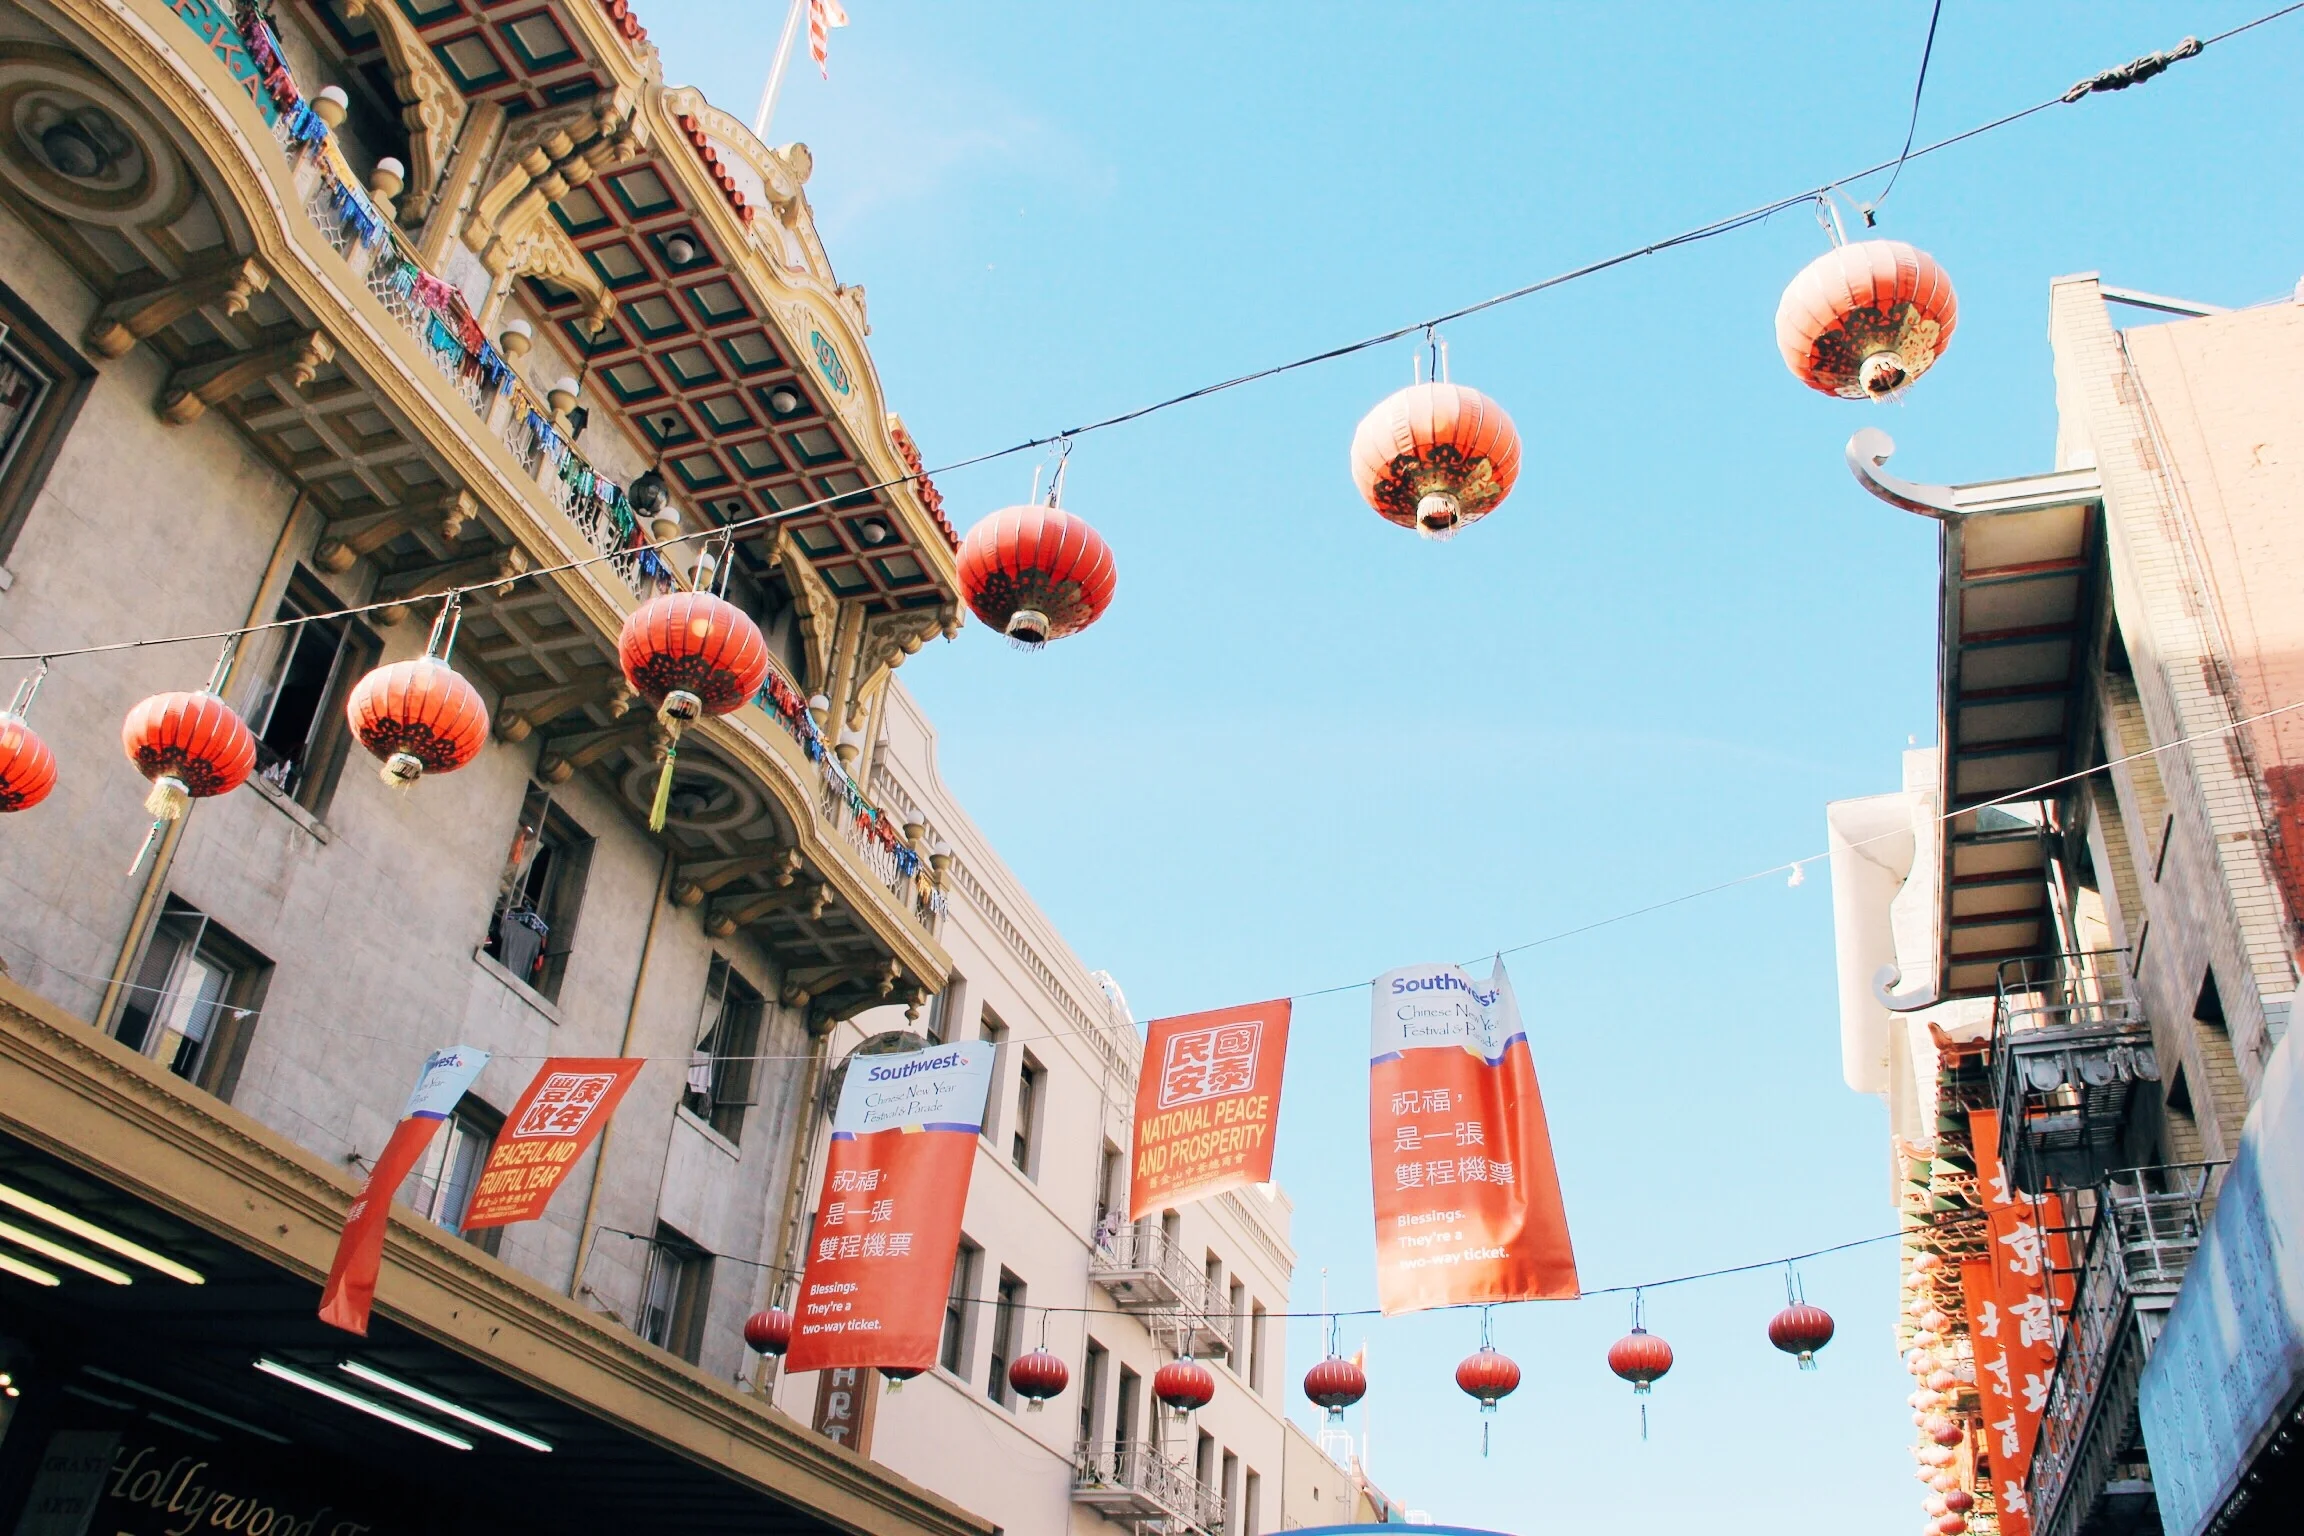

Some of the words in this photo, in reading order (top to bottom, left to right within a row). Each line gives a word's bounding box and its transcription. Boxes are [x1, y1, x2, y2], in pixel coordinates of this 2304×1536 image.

[816, 334, 845, 388] 1919
[1391, 973, 1496, 1007] Southwest
[1397, 1004, 1452, 1020] Chinese
[1403, 1023, 1449, 1038] Festival
[1452, 1024, 1463, 1034] &
[868, 1052, 960, 1081] Southwest
[865, 1092, 905, 1108] Chinese
[906, 1084, 929, 1099] New
[933, 1081, 957, 1096] Year
[864, 1105, 898, 1123] Festival
[907, 1100, 943, 1116] Parade
[1141, 1107, 1211, 1146] NATIONAL
[1214, 1096, 1269, 1129] PEACE
[1394, 1121, 1485, 1154] 是一張
[489, 1141, 548, 1168] PEACEFUL
[541, 1141, 577, 1162] AND
[1137, 1148, 1168, 1180] AND
[1170, 1123, 1266, 1169] PROSPERITY
[476, 1168, 527, 1197] FRUITFUL
[524, 1166, 561, 1189] YEAR
[1394, 1156, 1516, 1192] 雙程機票
[824, 1199, 894, 1228] 是一張
[1398, 1209, 1465, 1227] Blessings.
[816, 1232, 914, 1263] 雙程機票
[1398, 1231, 1451, 1249] They're
[1454, 1231, 1463, 1241] a
[1463, 1246, 1509, 1261] ticket.
[810, 1282, 859, 1296] Blessings.
[807, 1301, 843, 1316] They're
[845, 1302, 852, 1311] a
[803, 1320, 846, 1335] two-way
[847, 1319, 882, 1332] ticket.
